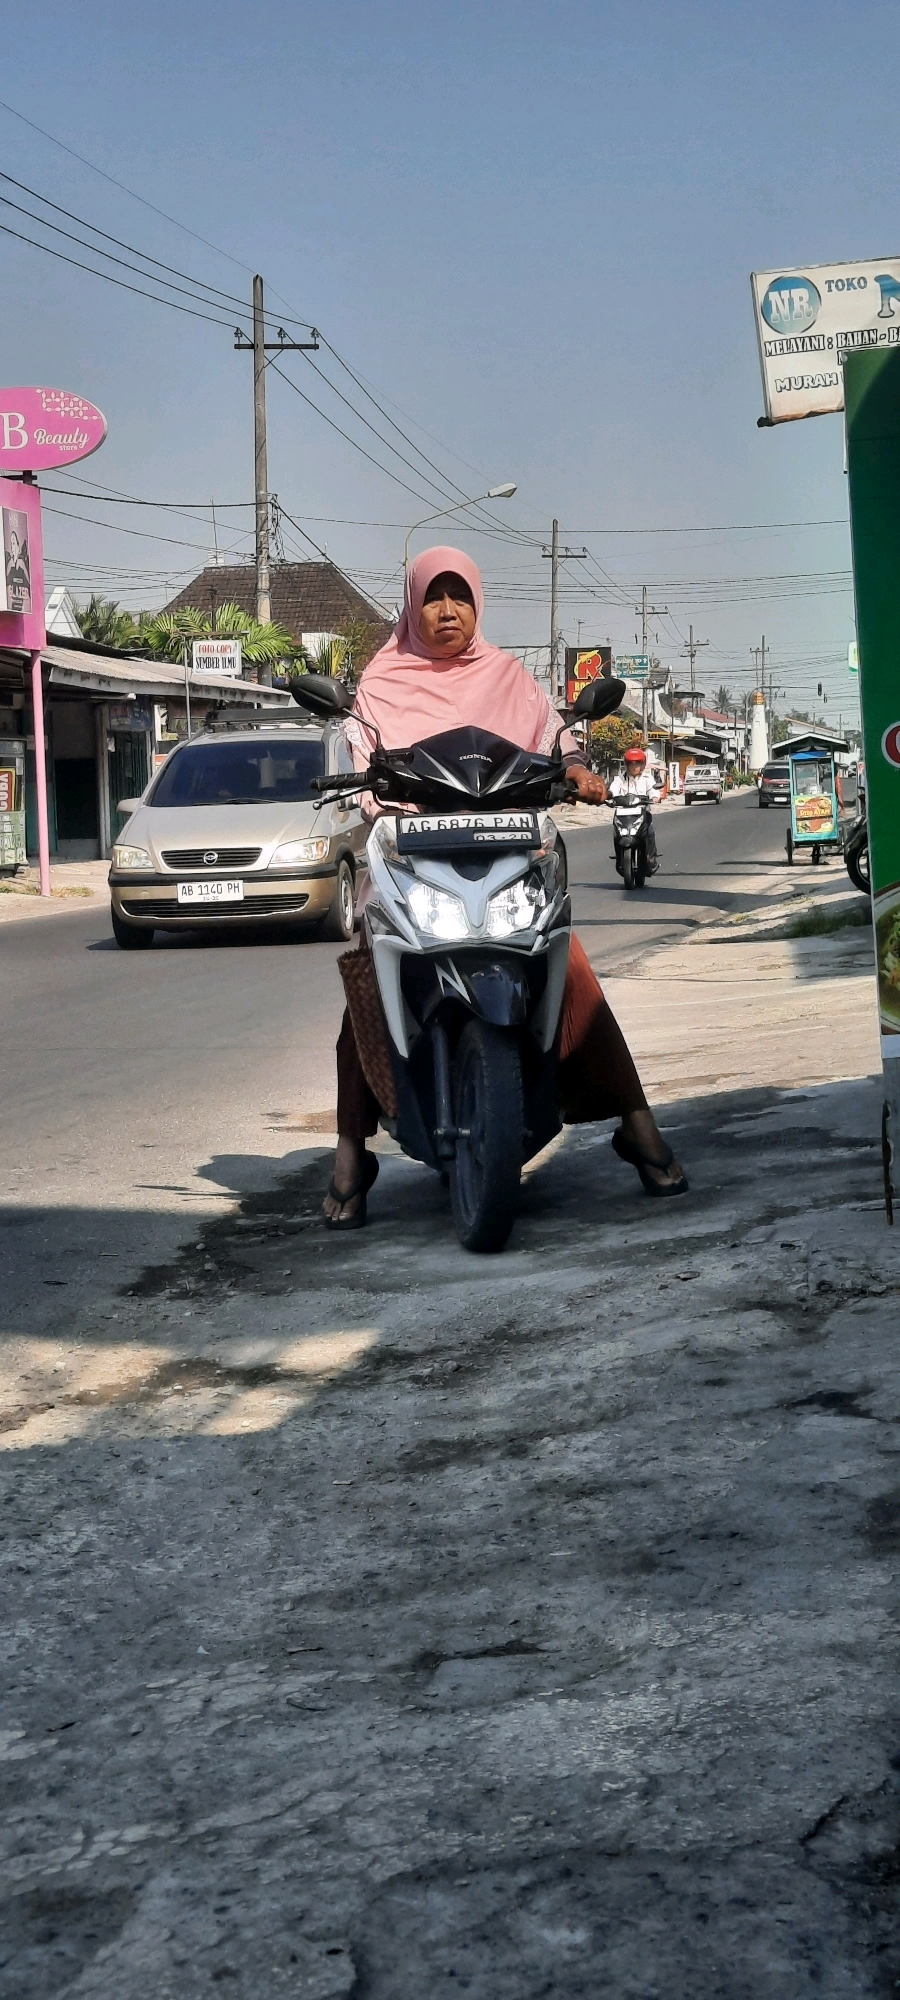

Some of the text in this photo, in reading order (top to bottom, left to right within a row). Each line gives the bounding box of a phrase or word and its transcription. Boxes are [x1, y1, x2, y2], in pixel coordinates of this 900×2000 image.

[825, 277, 868, 293] TOKO
[768, 287, 814, 323] NR
[764, 334, 825, 357] MELAYANI
[836, 329, 877, 348] BAHAN
[888, 327, 900, 343] B
[775, 372, 839, 393] MURAH
[33, 427, 89, 449] Beauty
[458, 753, 493, 763] HONDA
[407, 816, 530, 833] AG 6876 PAN
[181, 882, 240, 896] AB 1140 PH
